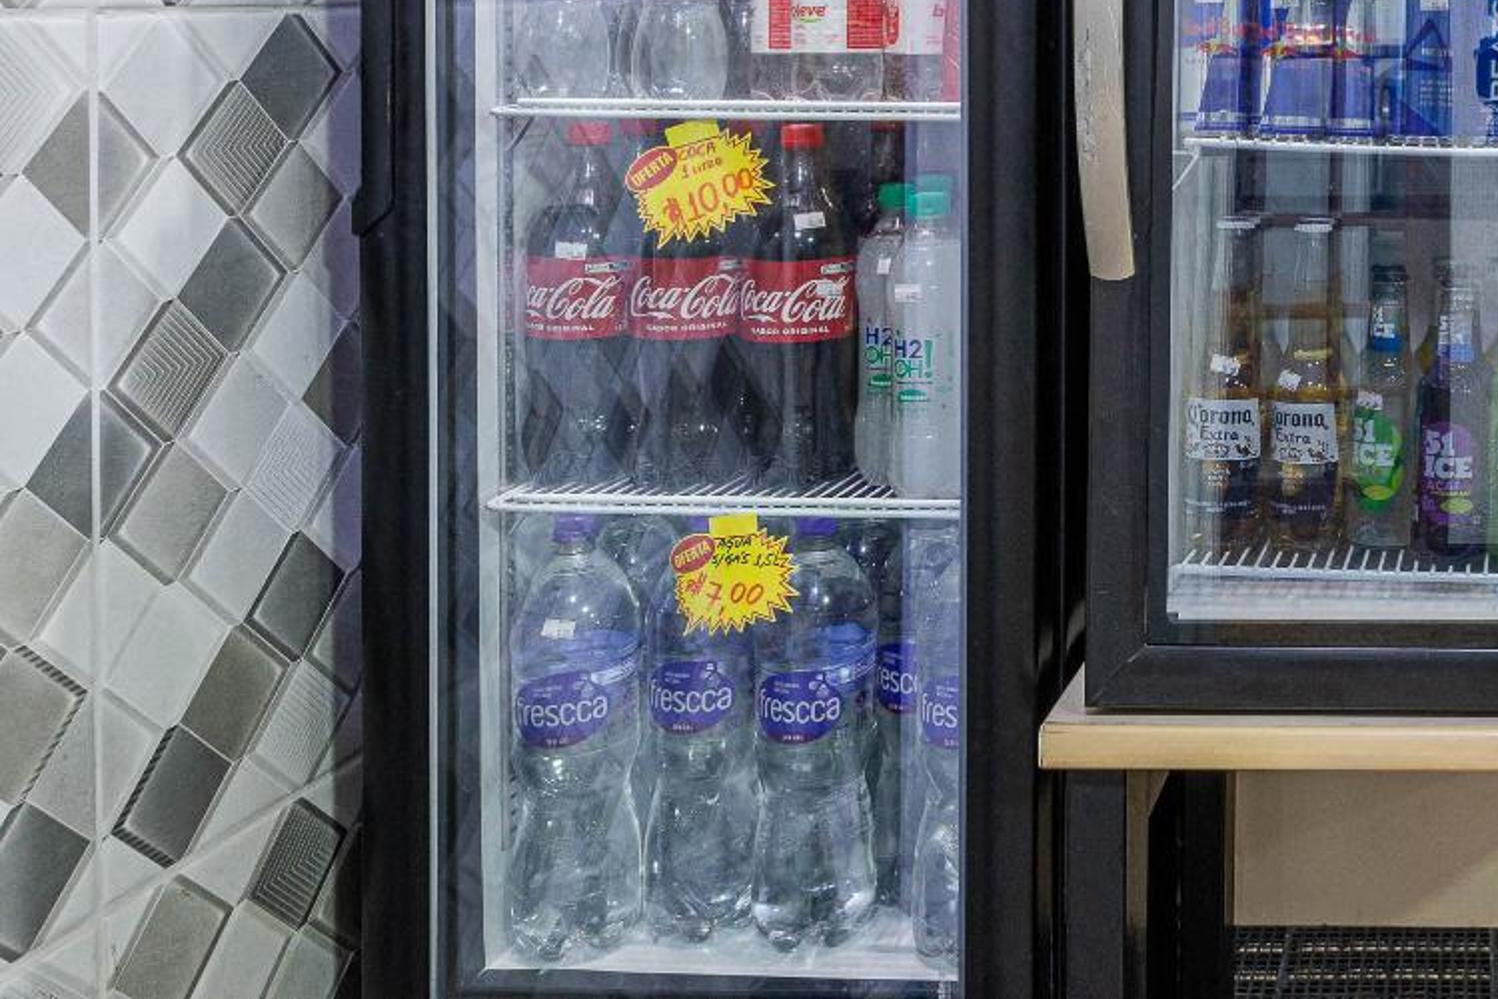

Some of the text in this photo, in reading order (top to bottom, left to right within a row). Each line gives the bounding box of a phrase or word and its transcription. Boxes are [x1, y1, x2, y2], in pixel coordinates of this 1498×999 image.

[1200, 425, 1241, 441] Extra
[1423, 429, 1456, 457] 51
[1423, 455, 1474, 480] ICE
[650, 677, 733, 713] frescca
[759, 687, 841, 725] frescca
[517, 695, 609, 728] frescca
